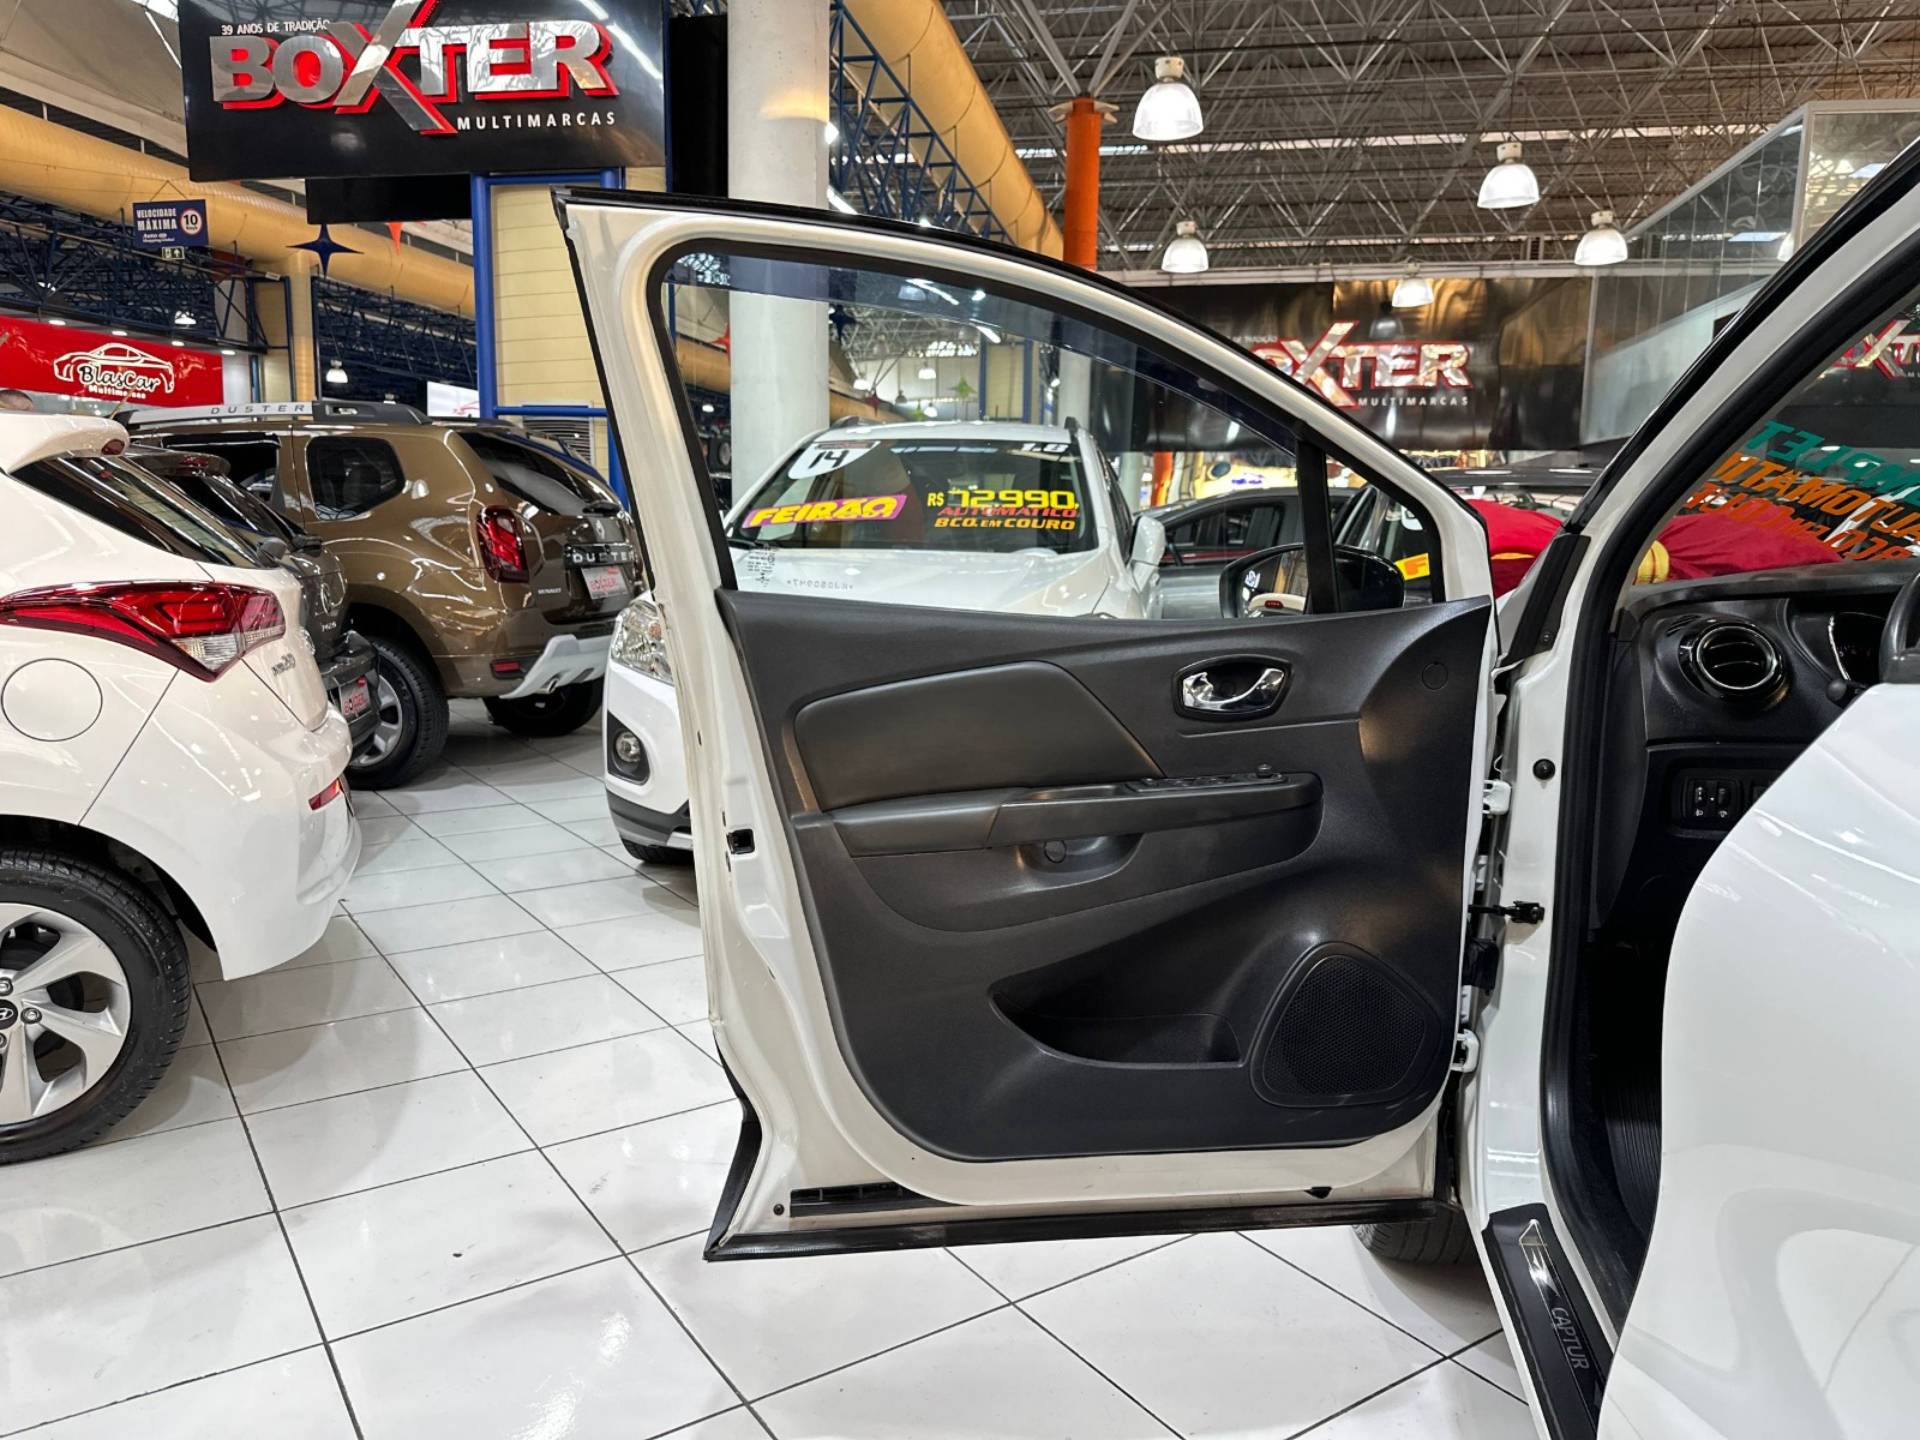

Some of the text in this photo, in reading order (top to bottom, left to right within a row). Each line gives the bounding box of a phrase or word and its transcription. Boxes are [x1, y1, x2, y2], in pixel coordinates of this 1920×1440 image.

[221, 25, 233, 35] 39
[237, 23, 263, 34] ANOS
[267, 22, 280, 33] DE
[210, 0, 620, 135] BOXTER
[457, 111, 616, 130] MULTIMARCAS
[183, 214, 198, 225] 10
[78, 362, 161, 392] BlasCar
[210, 399, 305, 415] DUSTER
[1358, 397, 1469, 406] MULTIMARCAS
[981, 520, 1001, 528] EM
[1004, 518, 1076, 530] COURO
[1550, 1306, 1590, 1370] CAPTUR
